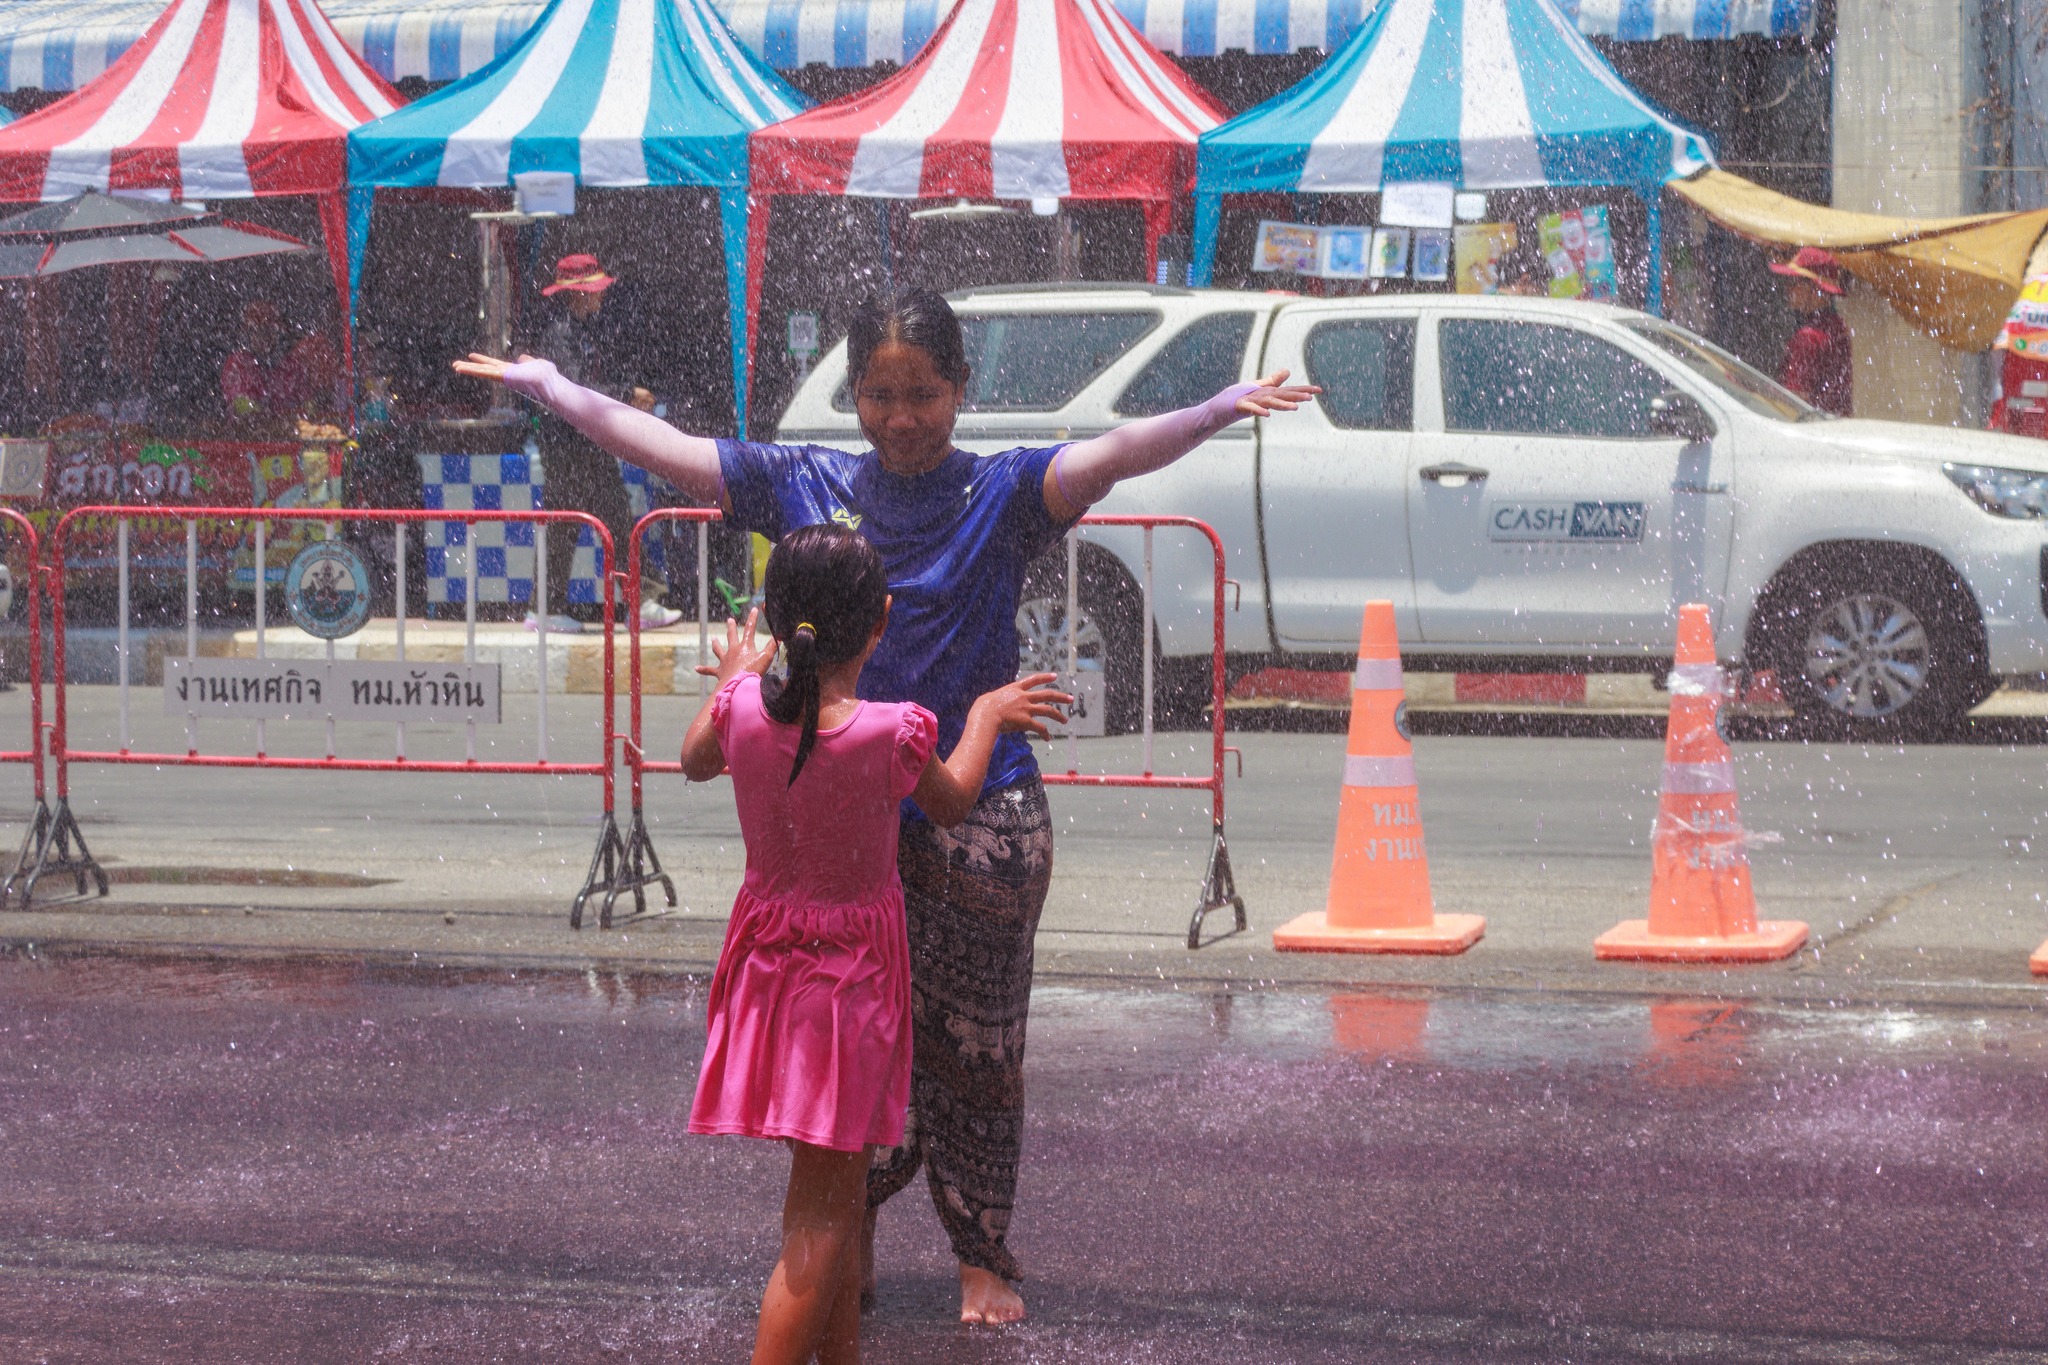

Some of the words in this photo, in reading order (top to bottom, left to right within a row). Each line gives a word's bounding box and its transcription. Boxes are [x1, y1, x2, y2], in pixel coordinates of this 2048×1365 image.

[1494, 507, 1568, 531] CASH
[1579, 508, 1639, 534] VAN
[176, 669, 322, 704] งานเทศกิจ
[351, 670, 485, 708] ทม.หัวหิน
